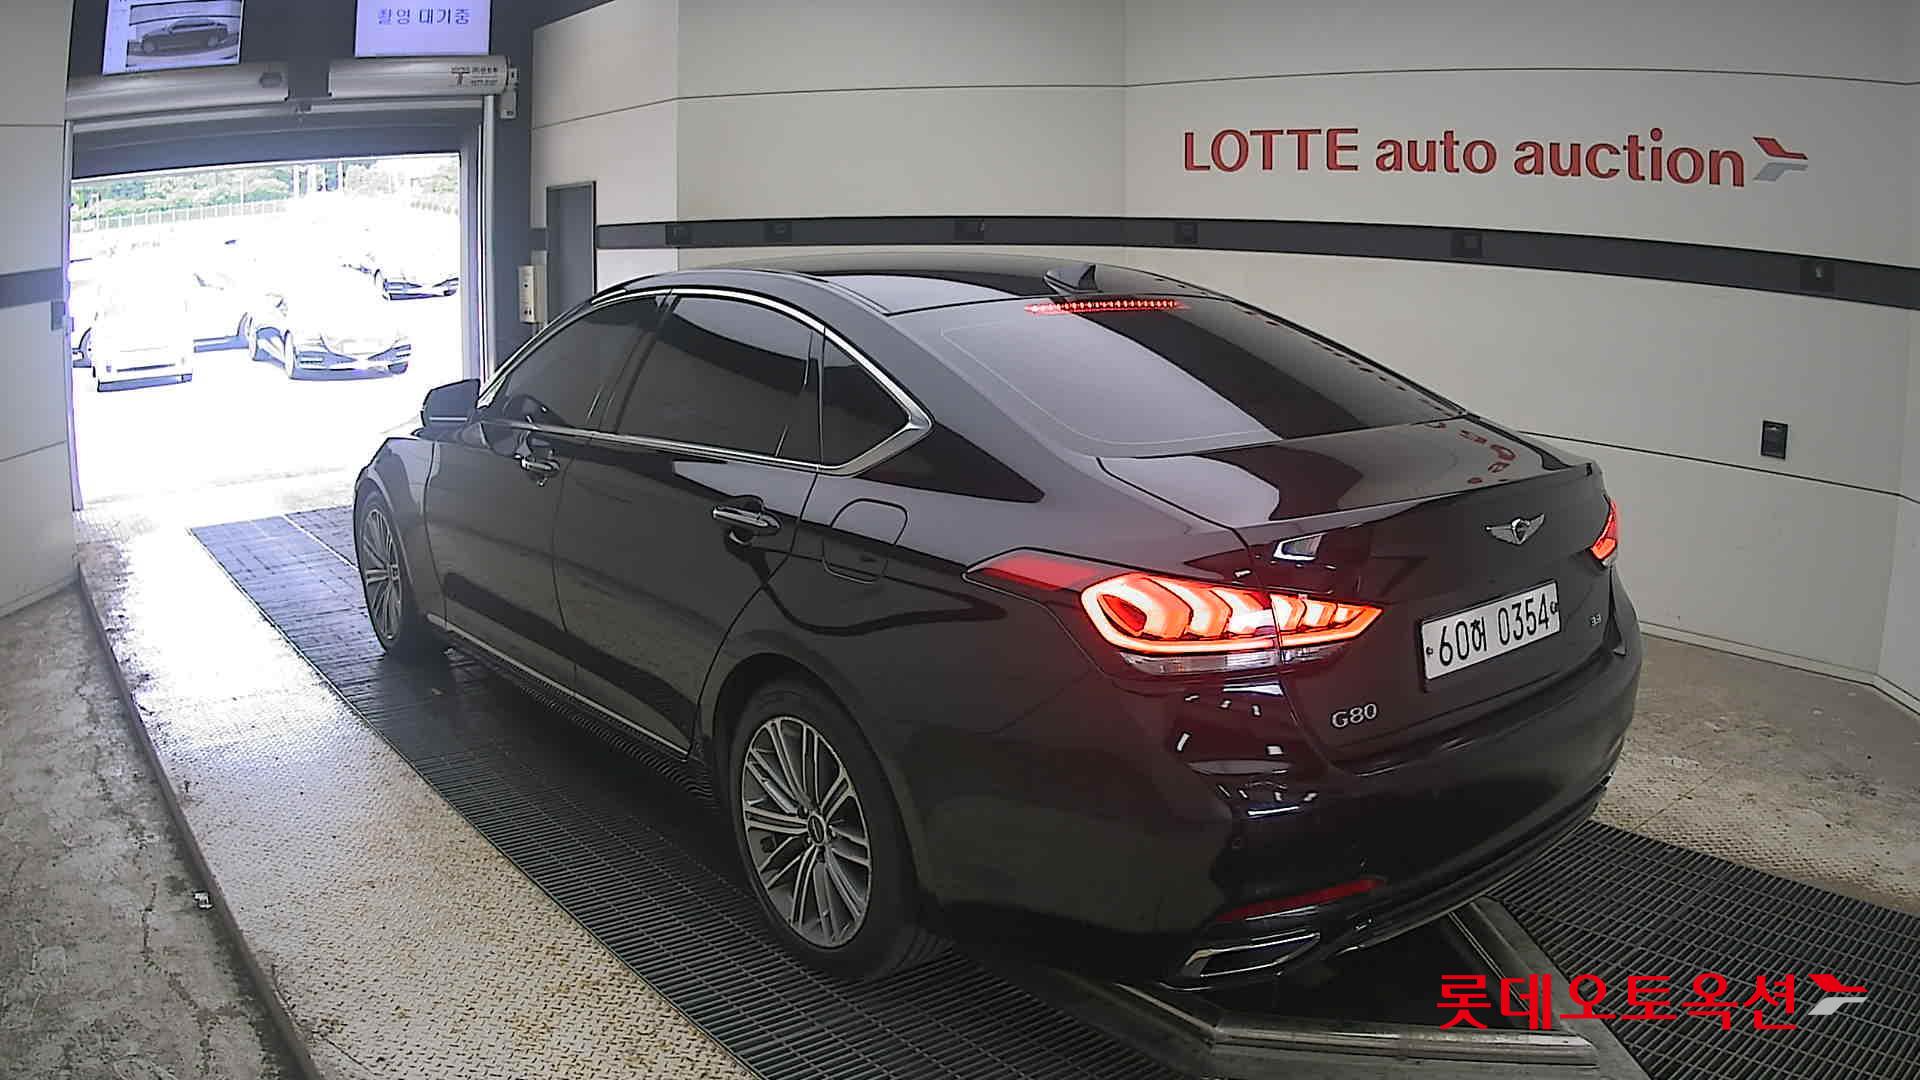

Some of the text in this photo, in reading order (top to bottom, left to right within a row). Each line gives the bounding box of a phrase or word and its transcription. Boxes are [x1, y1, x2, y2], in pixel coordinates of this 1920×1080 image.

[418, 8, 470, 25] 대기중
[1183, 127, 1745, 188] LOTTE auto auction
[1439, 592, 1550, 667] 60허 0354
[1331, 703, 1378, 729] G80
